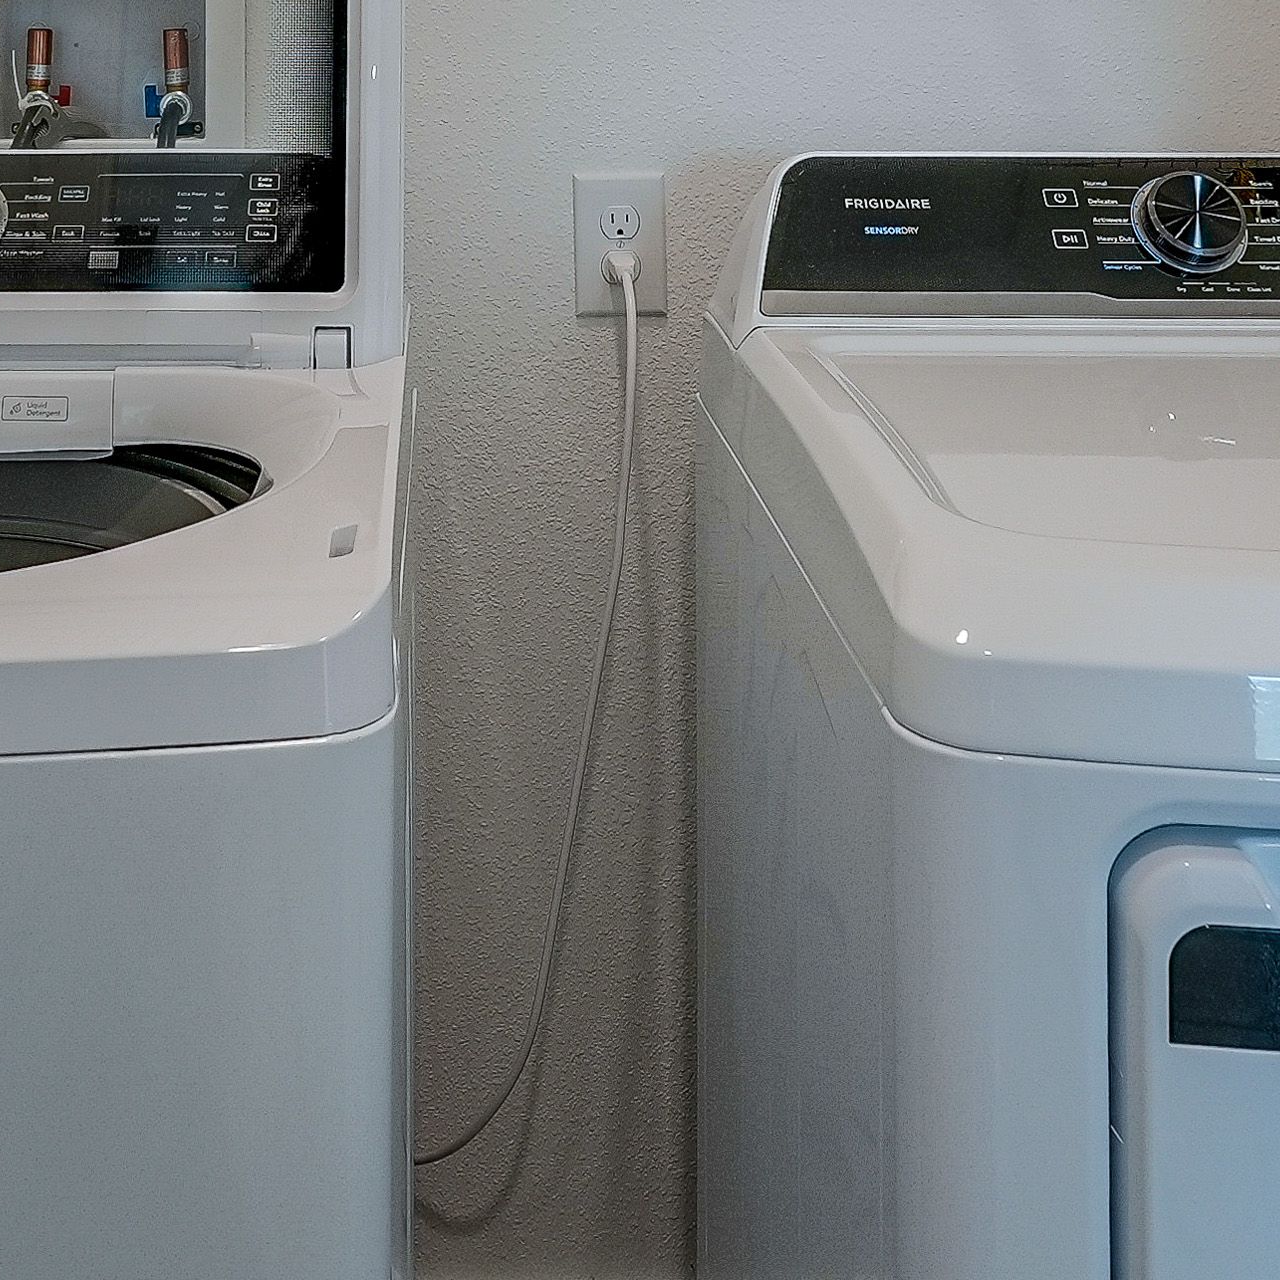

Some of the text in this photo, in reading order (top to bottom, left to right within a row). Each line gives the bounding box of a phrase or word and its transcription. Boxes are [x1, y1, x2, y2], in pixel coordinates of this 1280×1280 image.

[844, 198, 932, 209] FRIGIDAIRE
[863, 225, 920, 236] SENSORDRY
[1096, 235, 1136, 244] Heavy Duty
[27, 401, 48, 410] Liquid
